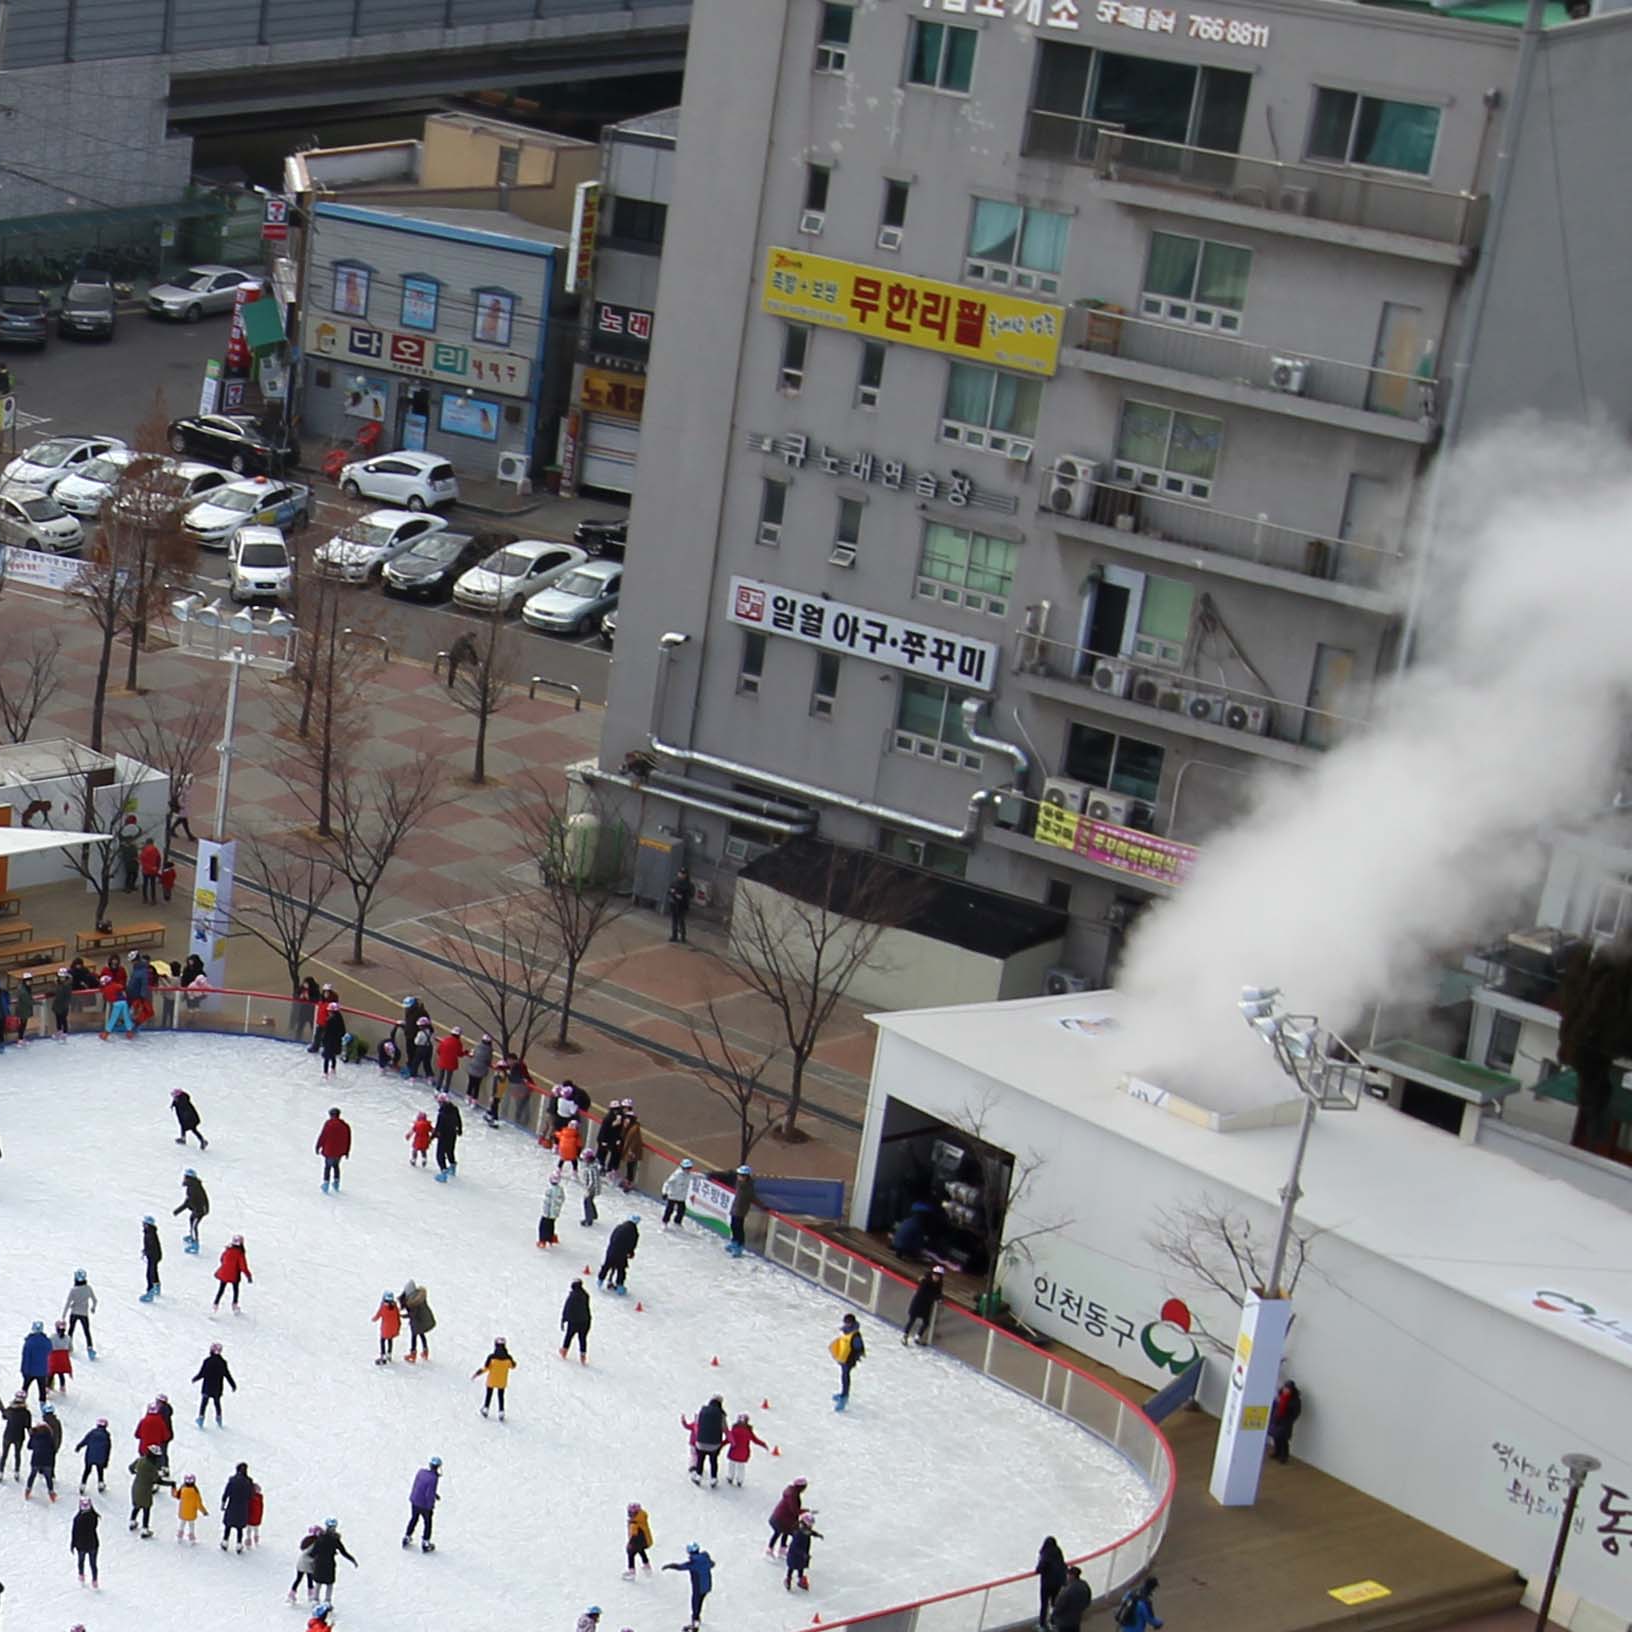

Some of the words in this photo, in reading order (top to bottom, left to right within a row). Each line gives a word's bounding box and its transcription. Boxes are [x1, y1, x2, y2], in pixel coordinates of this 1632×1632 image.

[599, 305, 651, 340] 노래
[850, 276, 986, 348] 무한리필
[352, 330, 466, 373] 다오리
[772, 594, 825, 639] 일월
[1033, 1275, 1135, 1349] 인천동구
